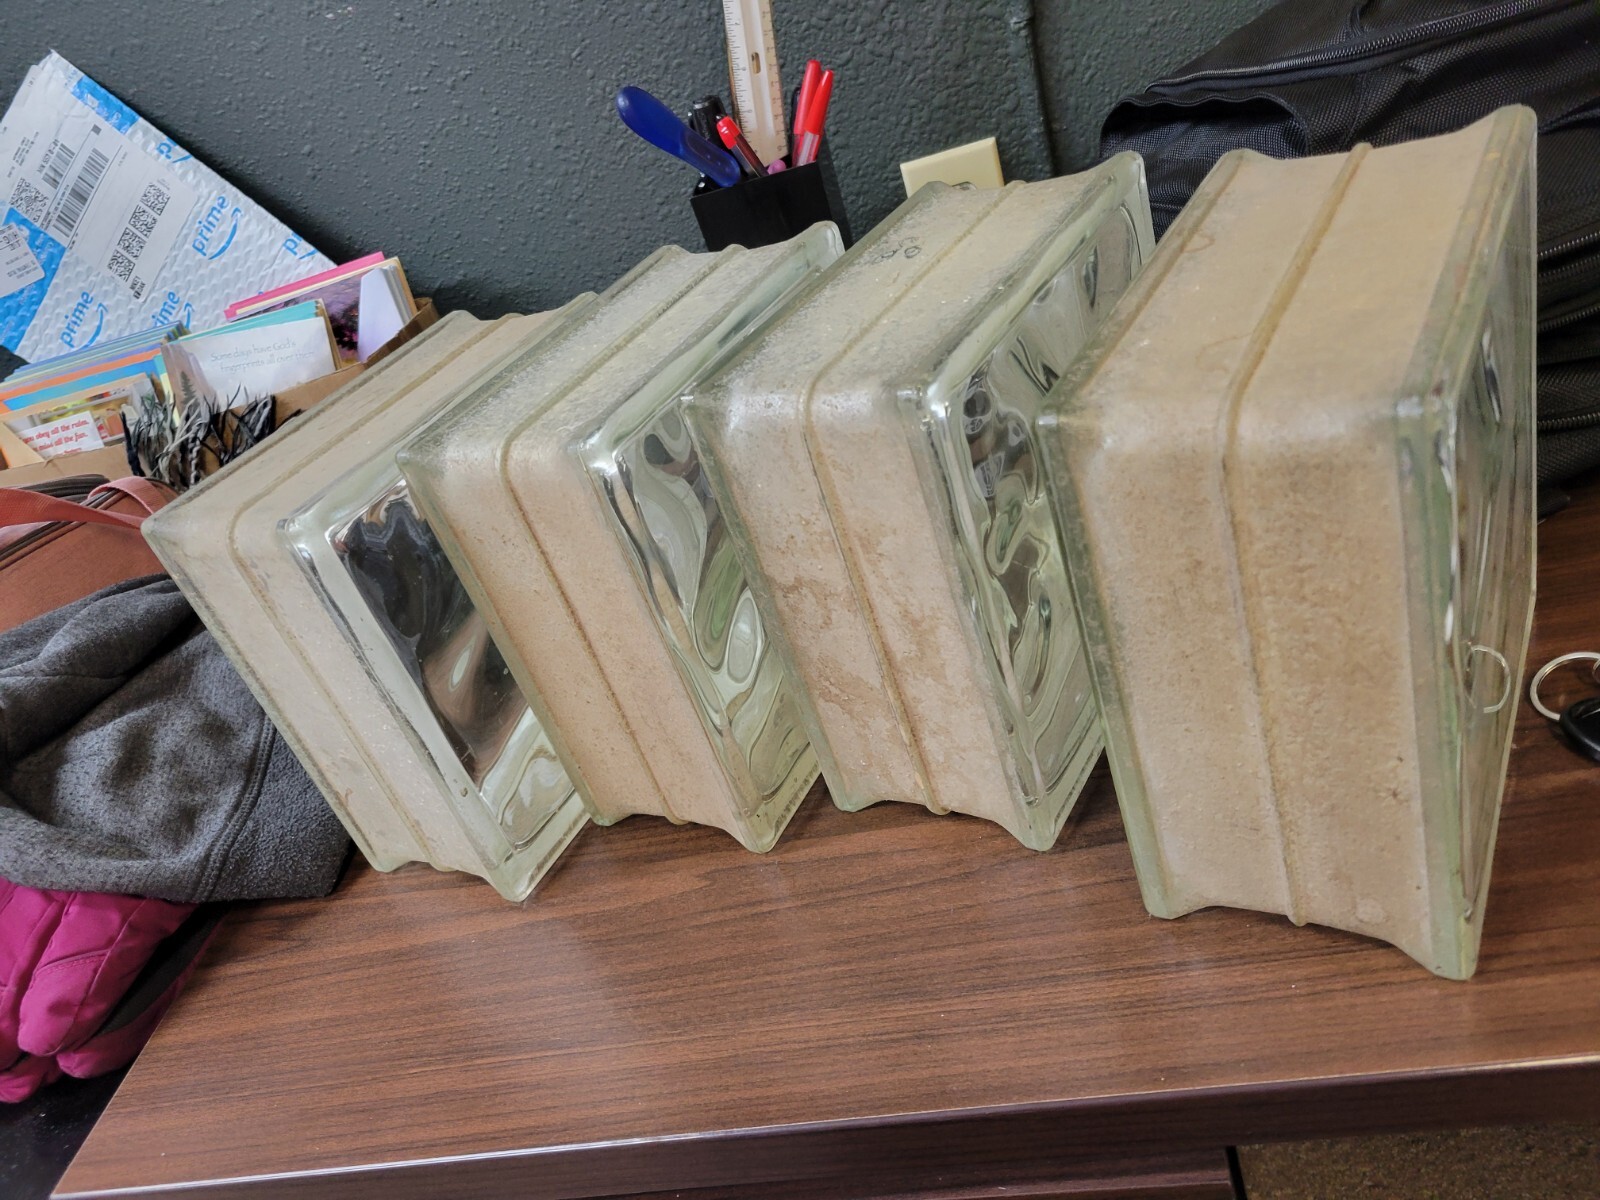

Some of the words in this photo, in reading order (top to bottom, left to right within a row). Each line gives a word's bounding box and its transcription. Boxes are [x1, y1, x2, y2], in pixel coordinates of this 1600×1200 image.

[192, 196, 229, 257] prime
[59, 290, 93, 348] prime
[151, 290, 180, 328] ime
[210, 352, 232, 362] Some
[233, 347, 252, 361] days
[252, 344, 271, 354] have
[272, 337, 297, 351] God's
[276, 354, 293, 364] over
[36, 431, 50, 439] obey
[51, 426, 60, 435] all
[61, 424, 70, 432] the
[38, 443, 53, 451] miss
[54, 437, 63, 446] all
